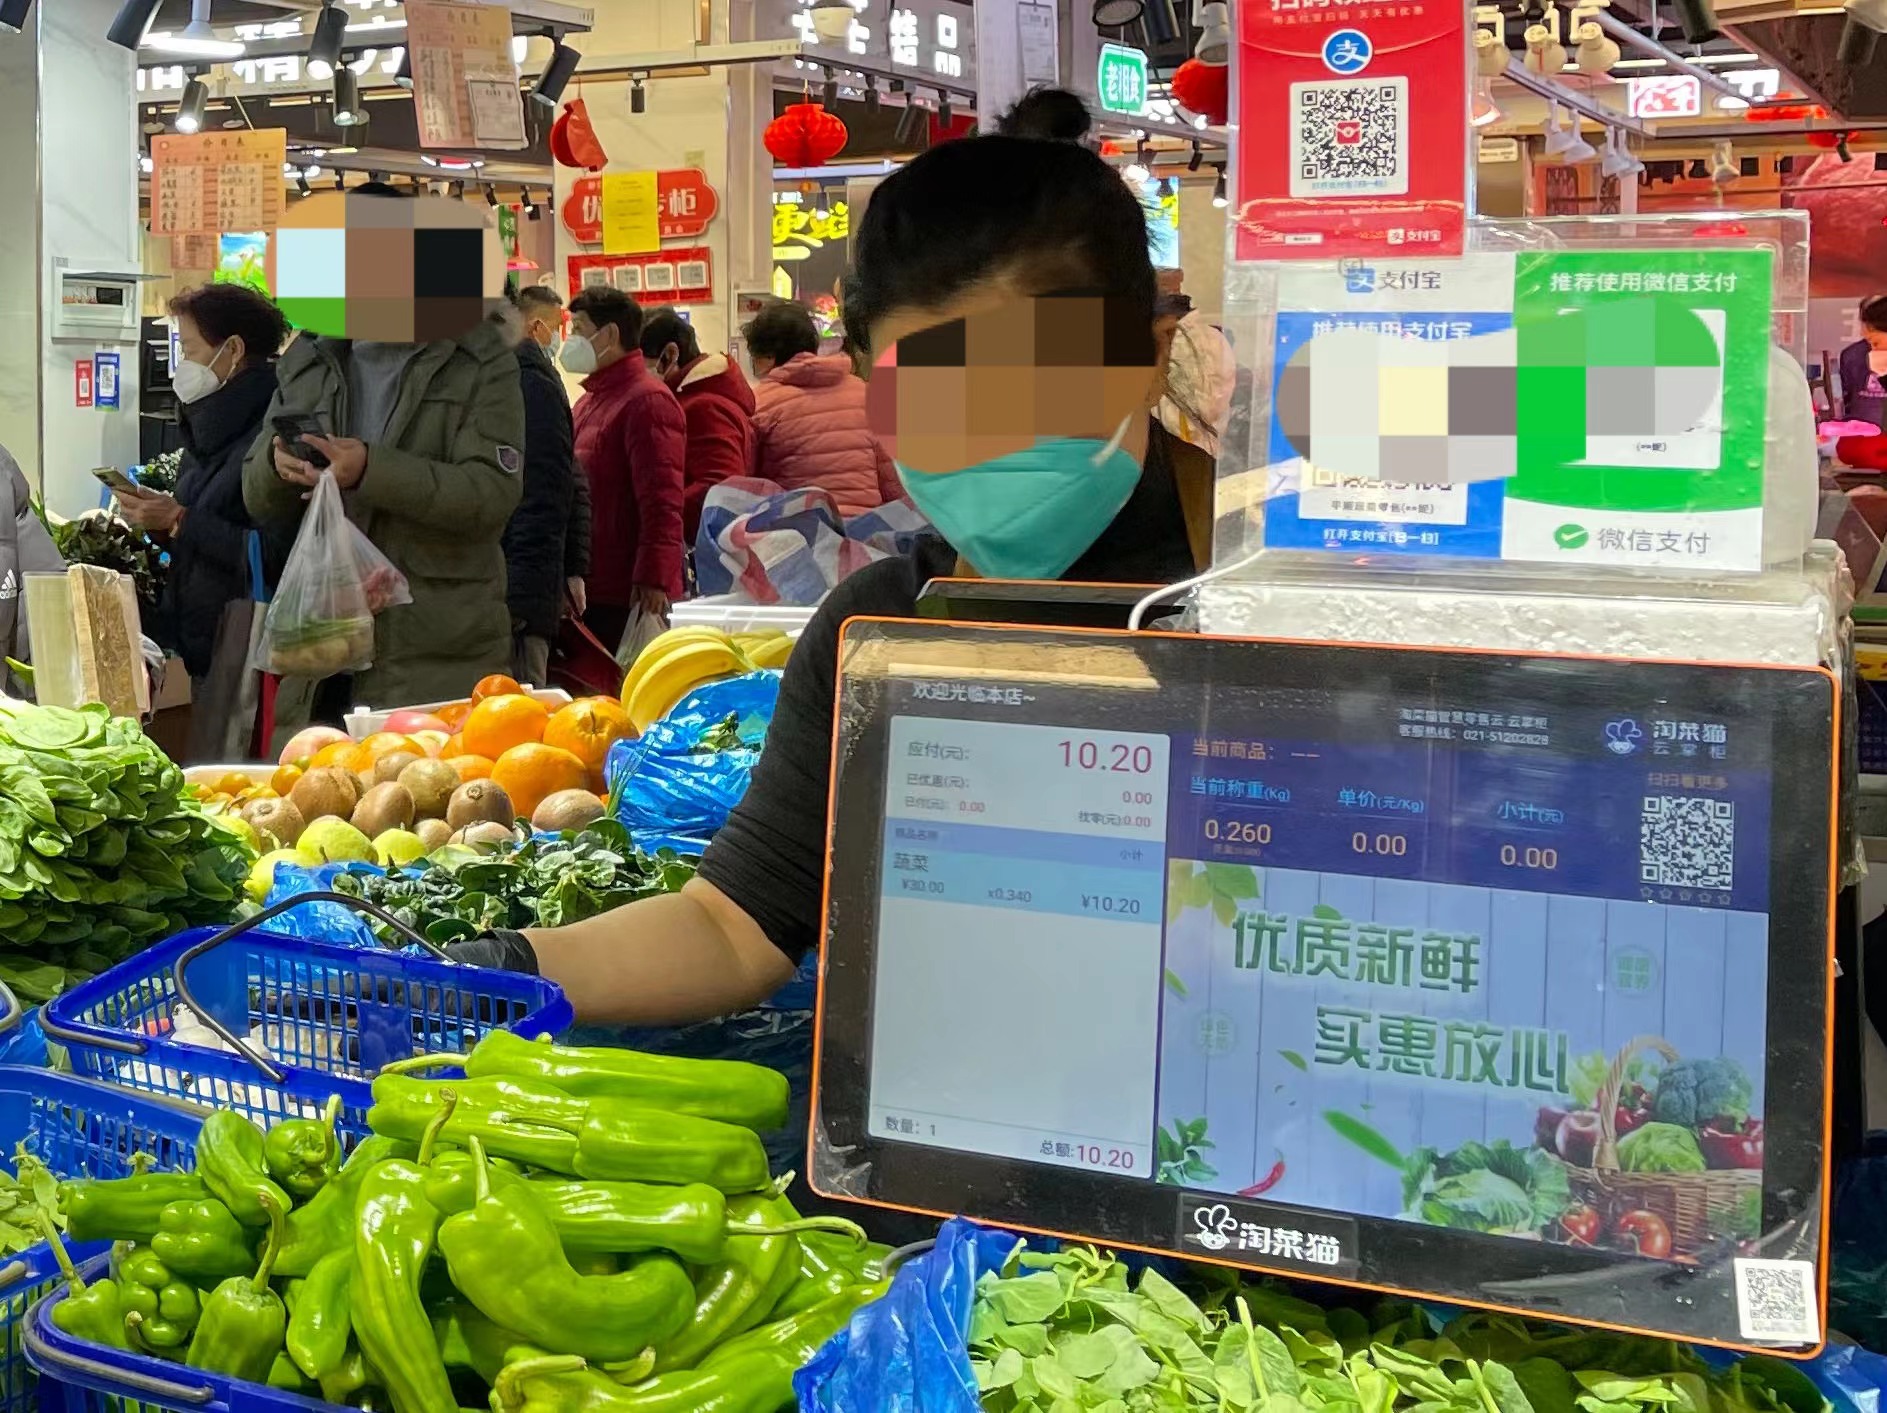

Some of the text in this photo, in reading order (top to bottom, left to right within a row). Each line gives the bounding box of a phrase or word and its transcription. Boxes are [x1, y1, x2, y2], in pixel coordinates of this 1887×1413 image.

[1378, 271, 1442, 290] 支付宝
[1549, 271, 1738, 293] 推荐使用微信支付
[1596, 527, 1712, 554] 微信支付
[1652, 719, 1728, 744] 淘菜猫
[1057, 740, 1153, 775] 10.20
[958, 800, 987, 814] 0.00
[1121, 790, 1153, 806] 0.00
[1497, 800, 1565, 825] 小计(元)
[1204, 818, 1272, 845] 0.260
[1351, 831, 1407, 857] 0.00
[1500, 844, 1558, 870] 0.00
[1080, 893, 1141, 915] ¥10.20
[1232, 908, 1481, 994] 优质新鲜
[1313, 1004, 1571, 1095] 实惠放心
[929, 1123, 937, 1137] 1
[1238, 1222, 1341, 1266] 淘菜猫
